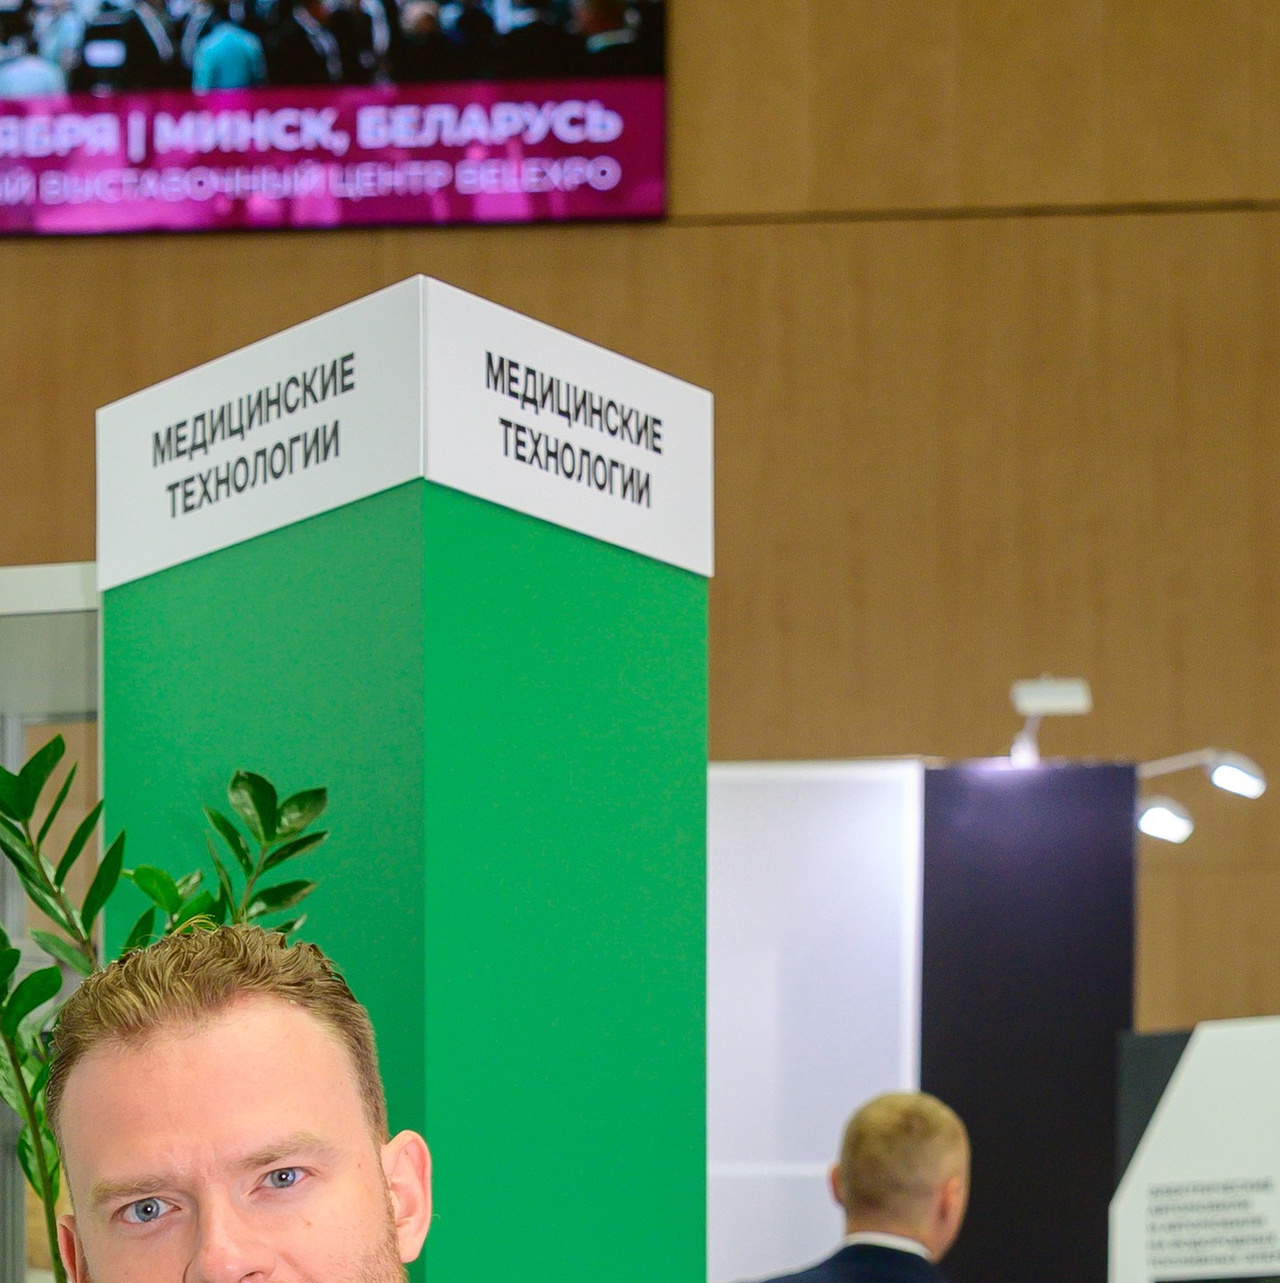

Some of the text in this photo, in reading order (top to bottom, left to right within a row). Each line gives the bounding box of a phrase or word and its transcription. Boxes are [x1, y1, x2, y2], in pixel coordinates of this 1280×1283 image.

[153, 107, 351, 157] МИНСК,
[356, 100, 623, 149] БЕЛАРУСЬ
[329, 161, 453, 200] ЦЕНТР
[153, 352, 355, 467] МЕДИЦИНСКИЕ
[485, 351, 663, 455] МЕДИЦИНСКИЕ
[167, 420, 340, 518] ТЕХНОЛОГИИ
[499, 417, 652, 508] ТЕХНОЛОГИИ
